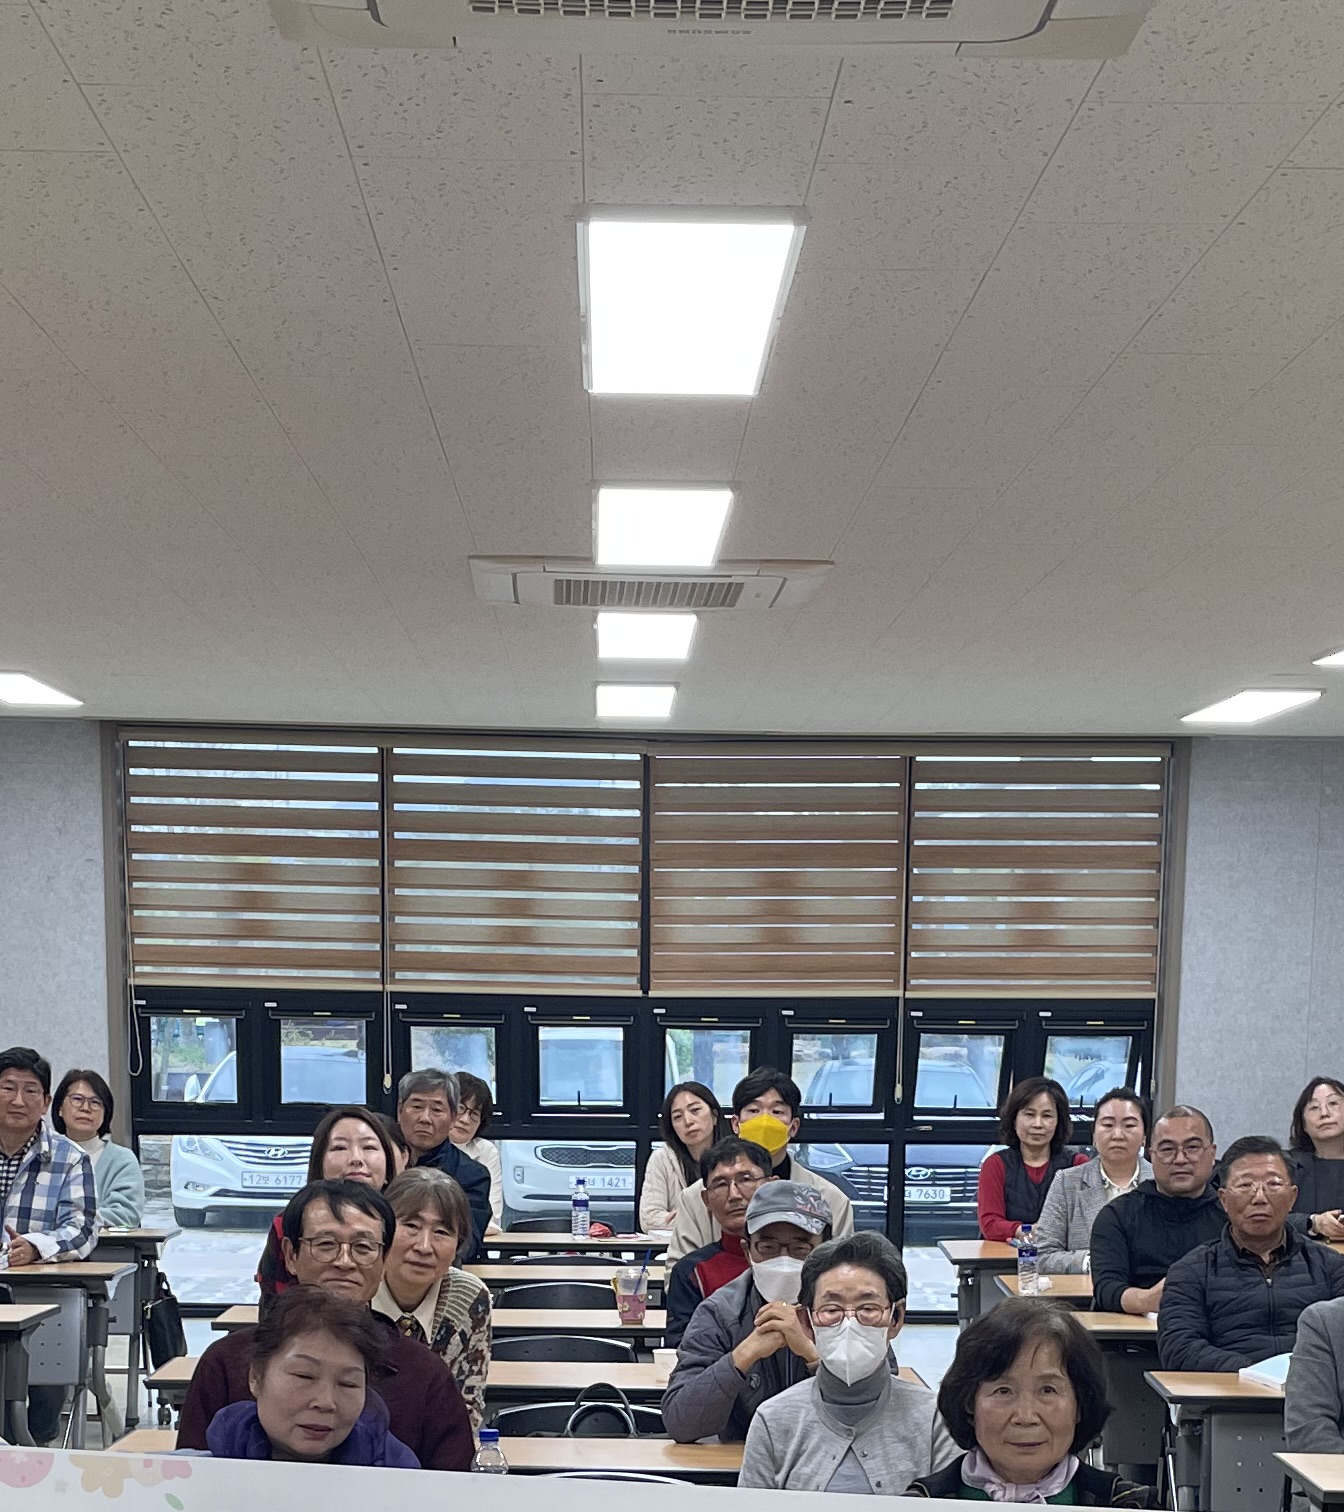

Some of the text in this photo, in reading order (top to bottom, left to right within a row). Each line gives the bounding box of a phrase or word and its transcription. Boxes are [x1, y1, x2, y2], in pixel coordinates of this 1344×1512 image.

[274, 1174, 303, 1185] 6177
[600, 1177, 627, 1188] 1421
[916, 1188, 945, 1200] 7630
